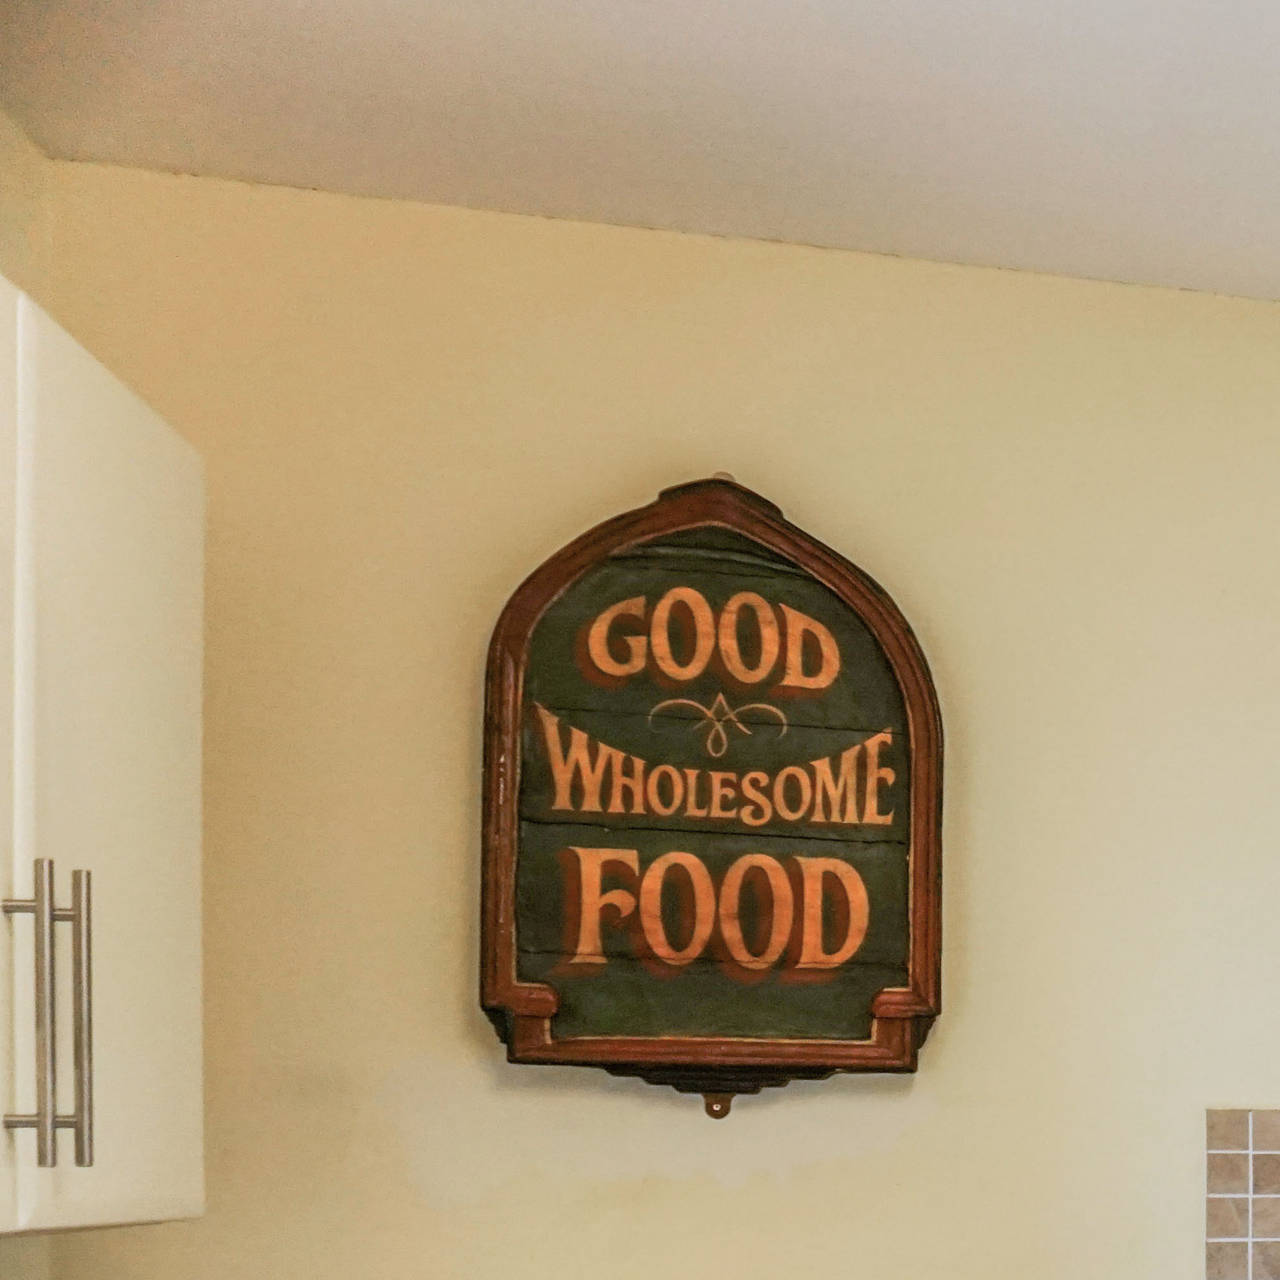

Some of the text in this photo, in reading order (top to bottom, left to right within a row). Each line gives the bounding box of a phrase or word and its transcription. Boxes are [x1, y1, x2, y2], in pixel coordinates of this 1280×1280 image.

[587, 586, 842, 690] GOOD
[533, 702, 896, 827] WHOLESOME
[568, 847, 870, 971] FOOD
